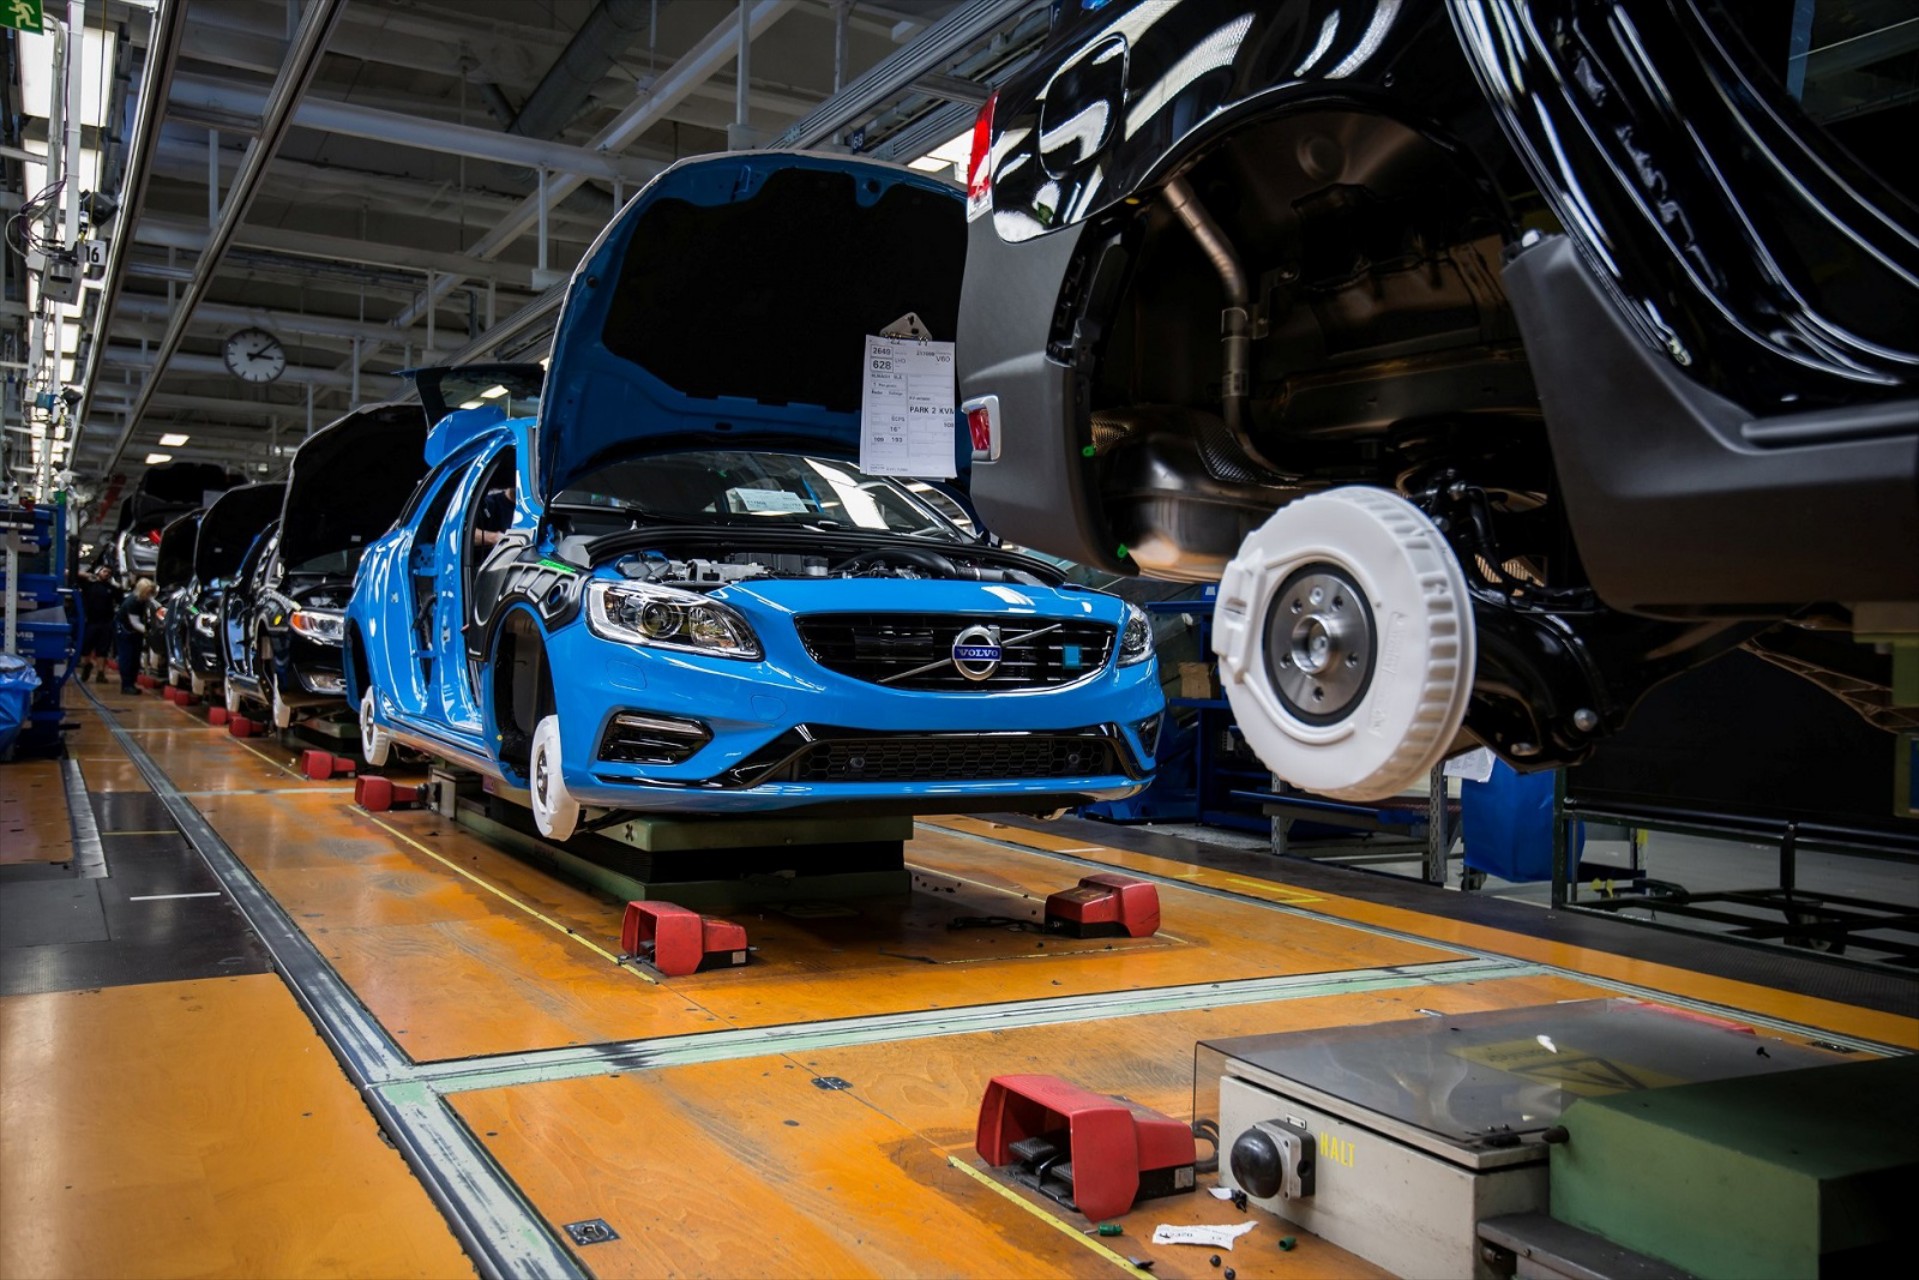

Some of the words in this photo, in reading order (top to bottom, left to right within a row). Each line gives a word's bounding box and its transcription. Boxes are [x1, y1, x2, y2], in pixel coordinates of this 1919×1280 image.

[86, 246, 100, 263] 16
[873, 360, 891, 370] 628
[910, 406, 929, 414] PARK
[958, 648, 998, 657] VOLVO
[1319, 1131, 1355, 1168] HALT
